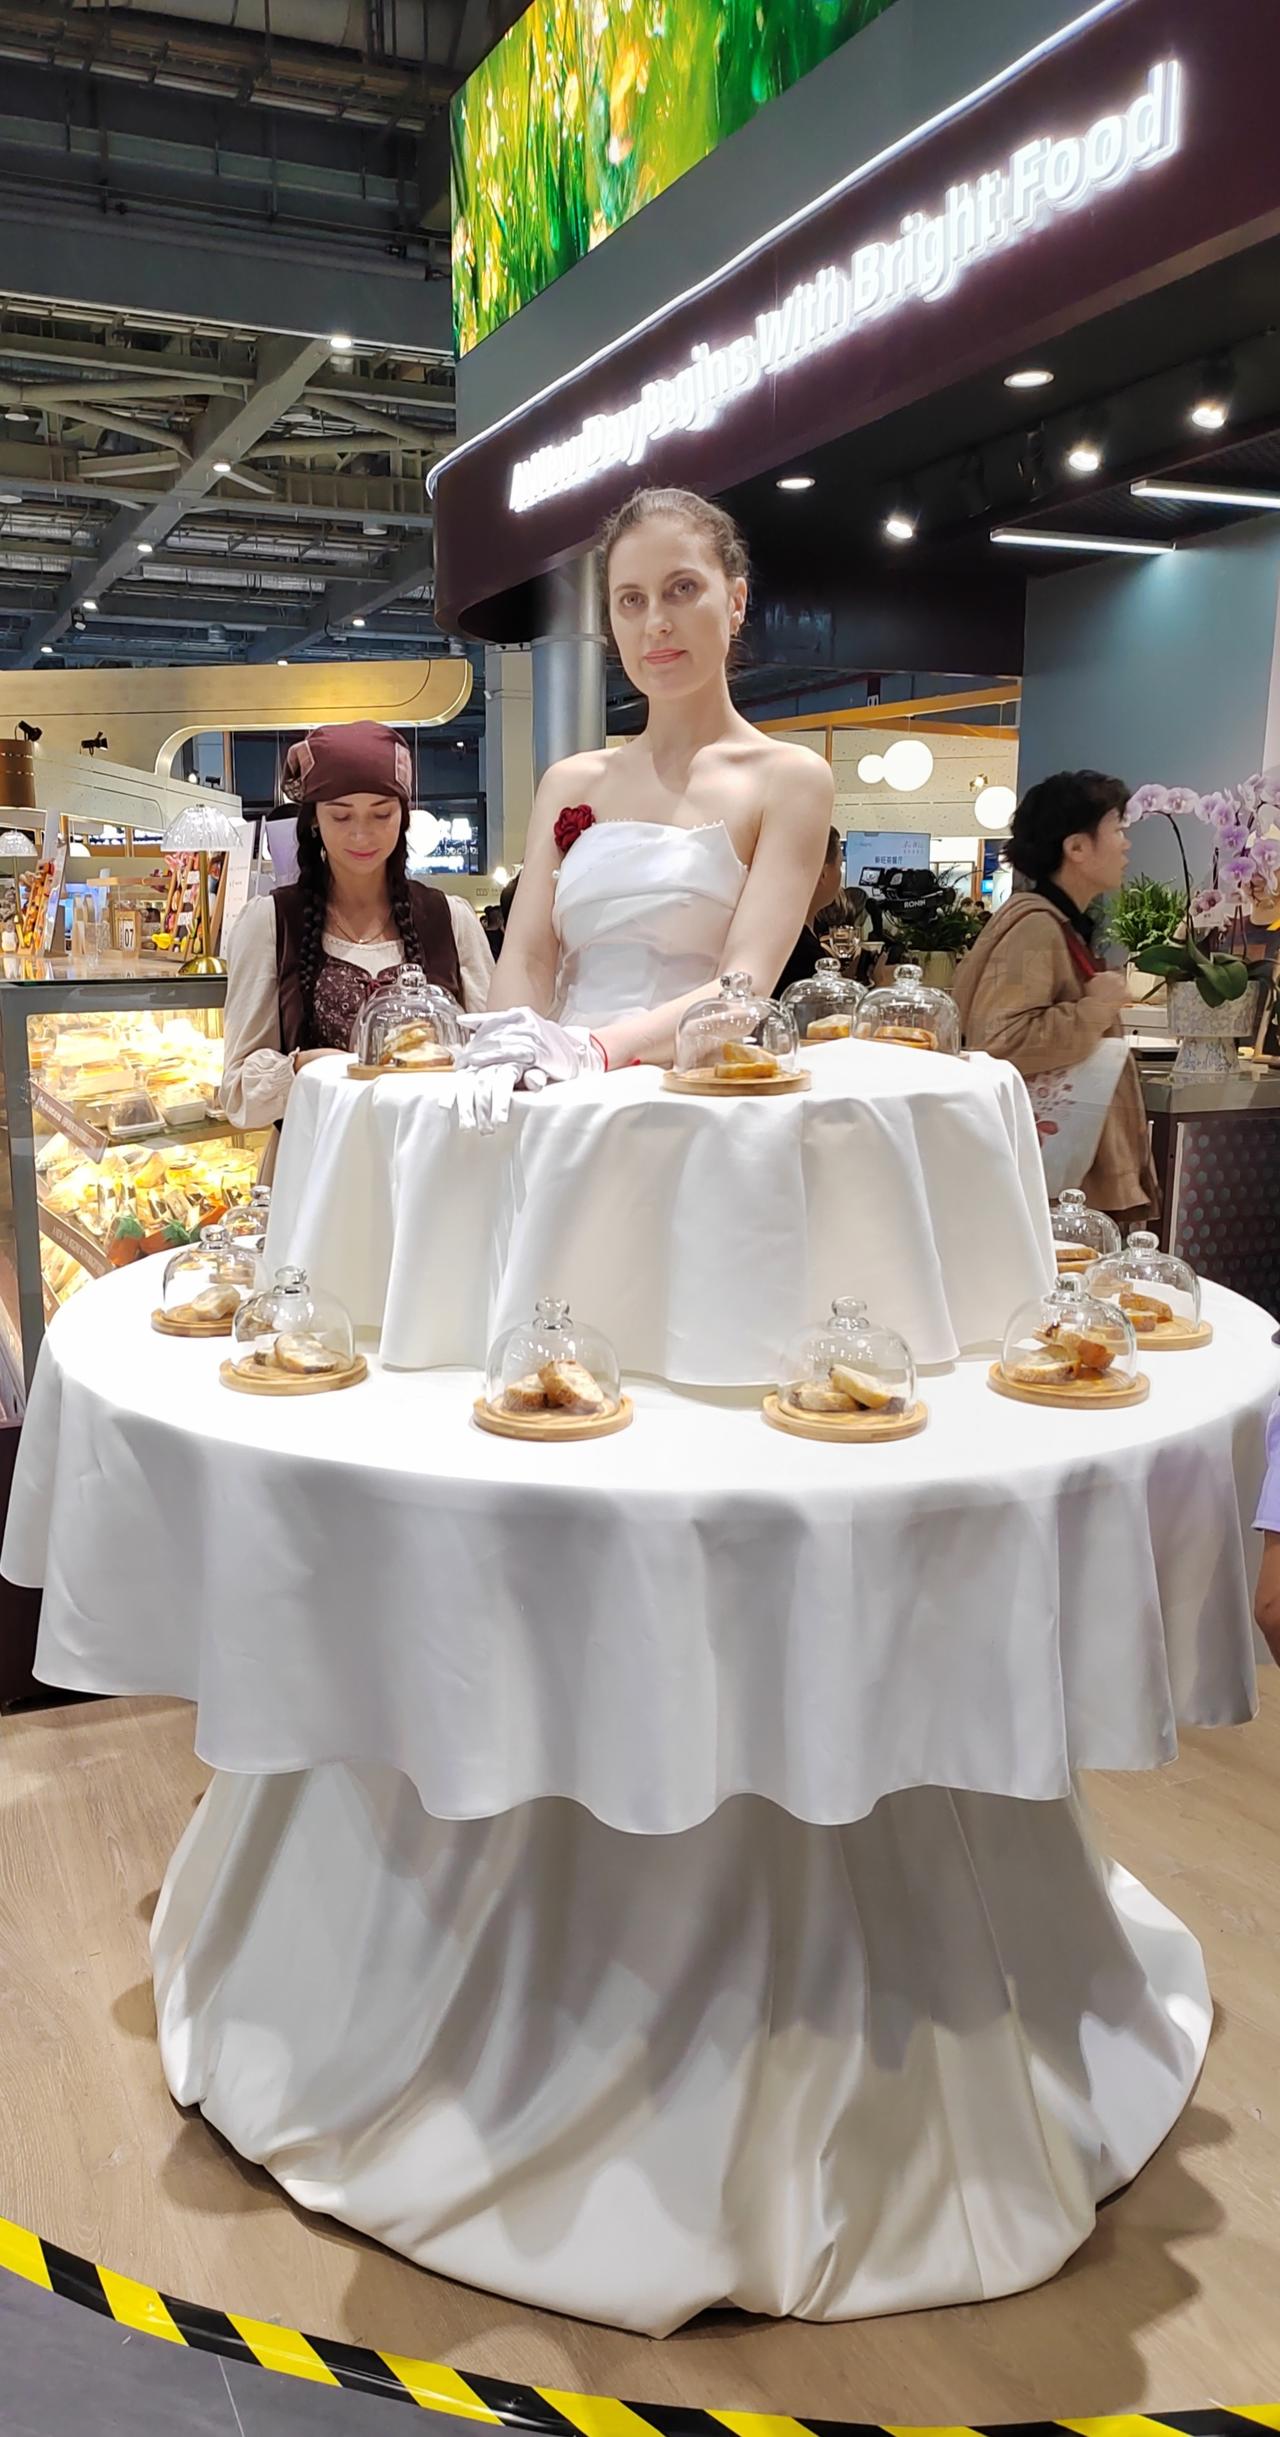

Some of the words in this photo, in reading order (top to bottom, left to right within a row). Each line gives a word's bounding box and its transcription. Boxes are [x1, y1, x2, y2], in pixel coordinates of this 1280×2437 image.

[582, 402, 648, 468] Day
[640, 334, 761, 442] Begins
[755, 265, 851, 376] With
[851, 168, 1008, 303] Bright
[1009, 60, 1181, 232] Food
[903, 899, 926, 909] RONIN
